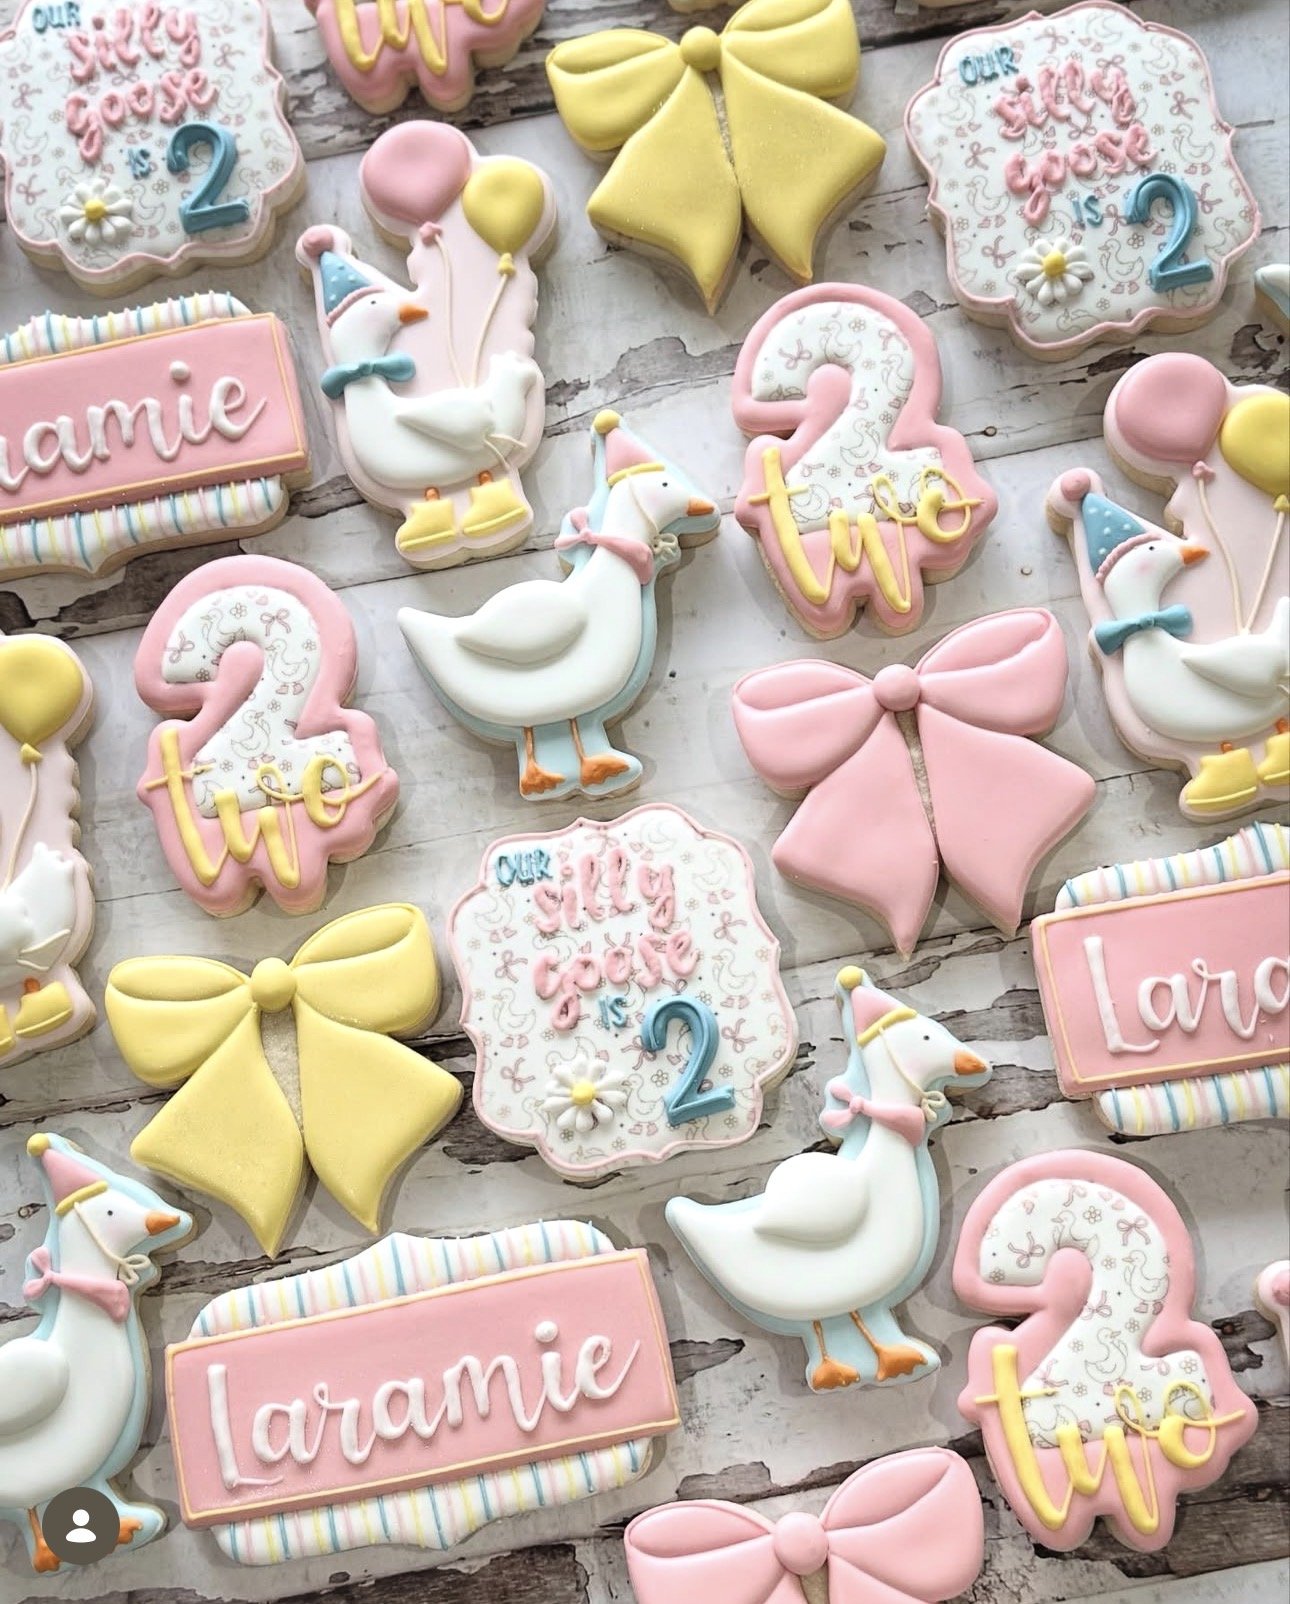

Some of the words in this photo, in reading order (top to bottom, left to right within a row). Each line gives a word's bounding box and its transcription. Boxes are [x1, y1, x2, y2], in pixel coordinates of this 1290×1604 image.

[68, 1, 201, 81] silly
[65, 67, 219, 165] goose
[993, 59, 1137, 140] silly
[167, 122, 250, 234] 2
[1005, 124, 1158, 227] goose
[1126, 173, 1214, 293] 2
[749, 447, 984, 613] two
[144, 728, 385, 888] two
[533, 847, 677, 933] silly
[532, 931, 700, 1032] goose
[641, 995, 736, 1127] 2
[207, 1320, 640, 1491] Laramie
[975, 1344, 1247, 1535] two
